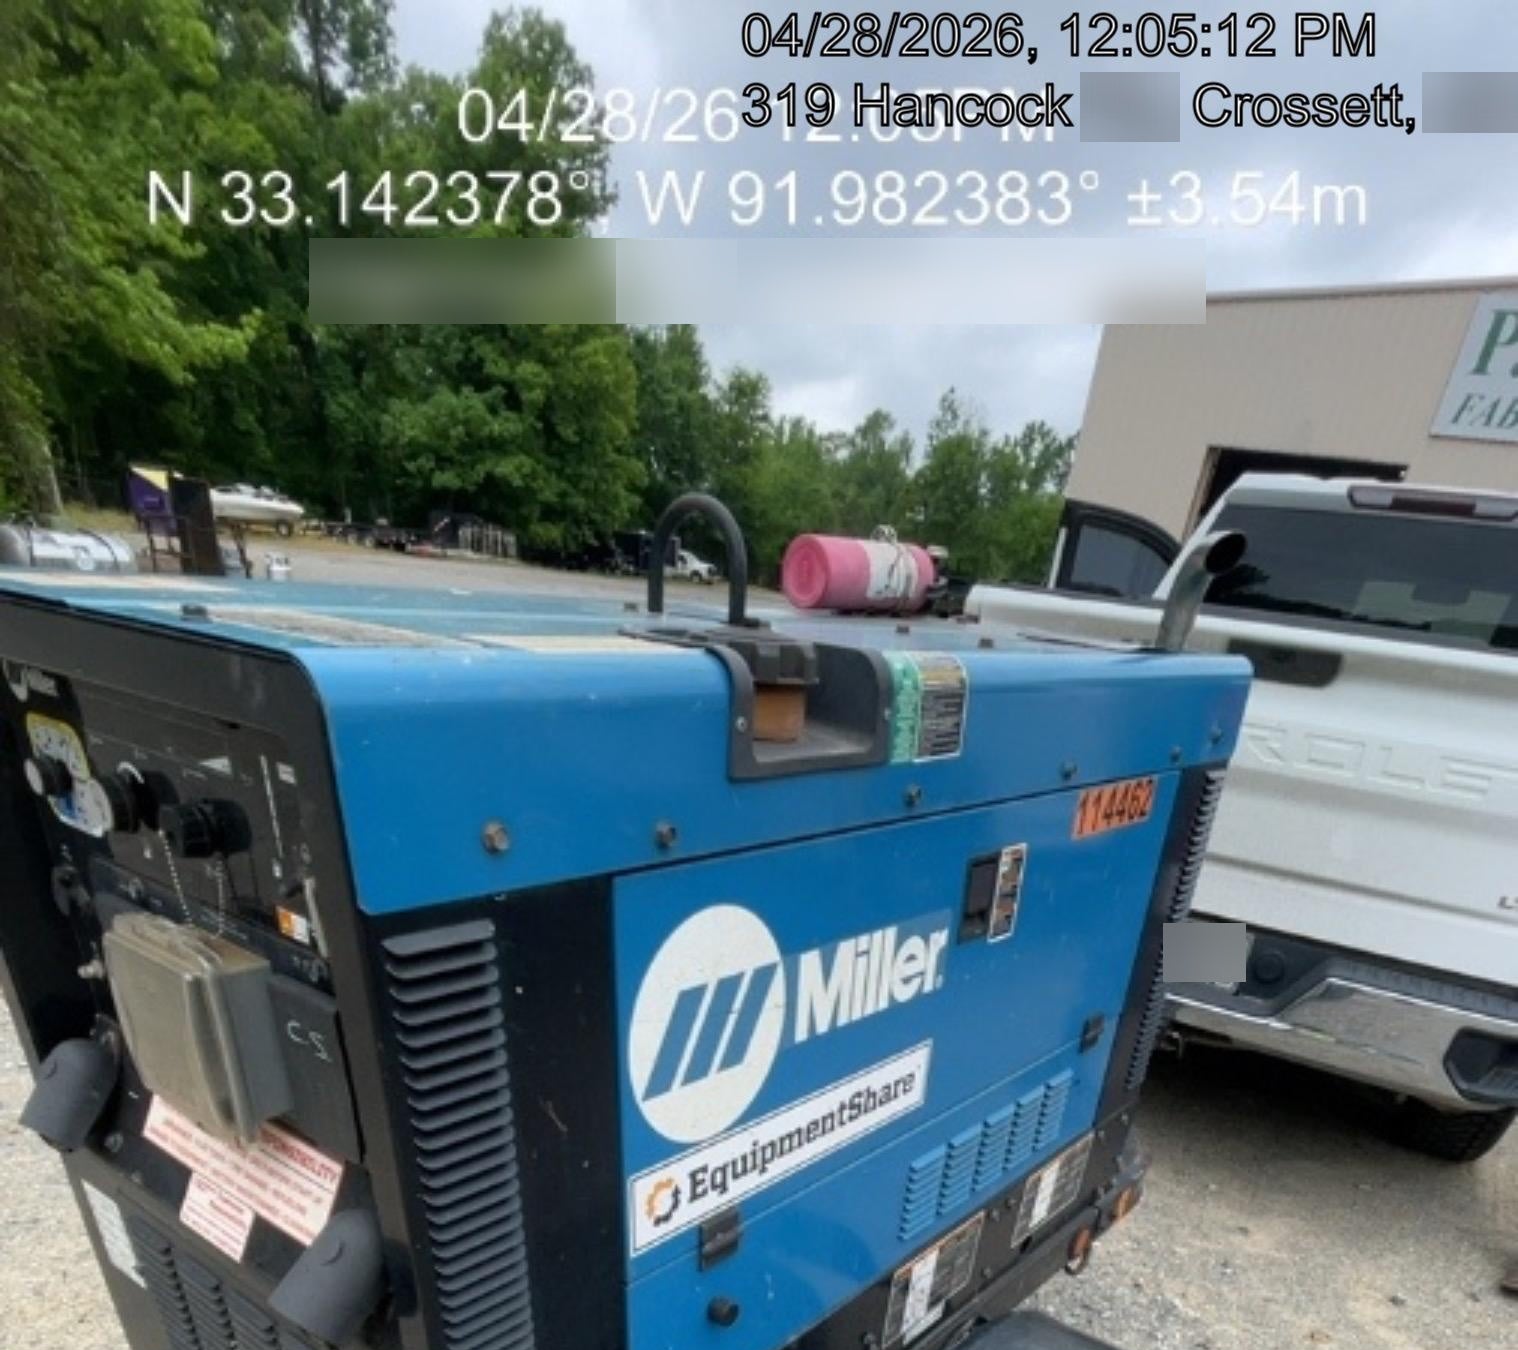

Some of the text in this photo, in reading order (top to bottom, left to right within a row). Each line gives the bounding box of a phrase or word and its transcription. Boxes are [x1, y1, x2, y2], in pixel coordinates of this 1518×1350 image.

[1077, 777, 1155, 836] 114462
[794, 923, 950, 1044] Miller
[687, 1069, 918, 1203] EquipmentShare
